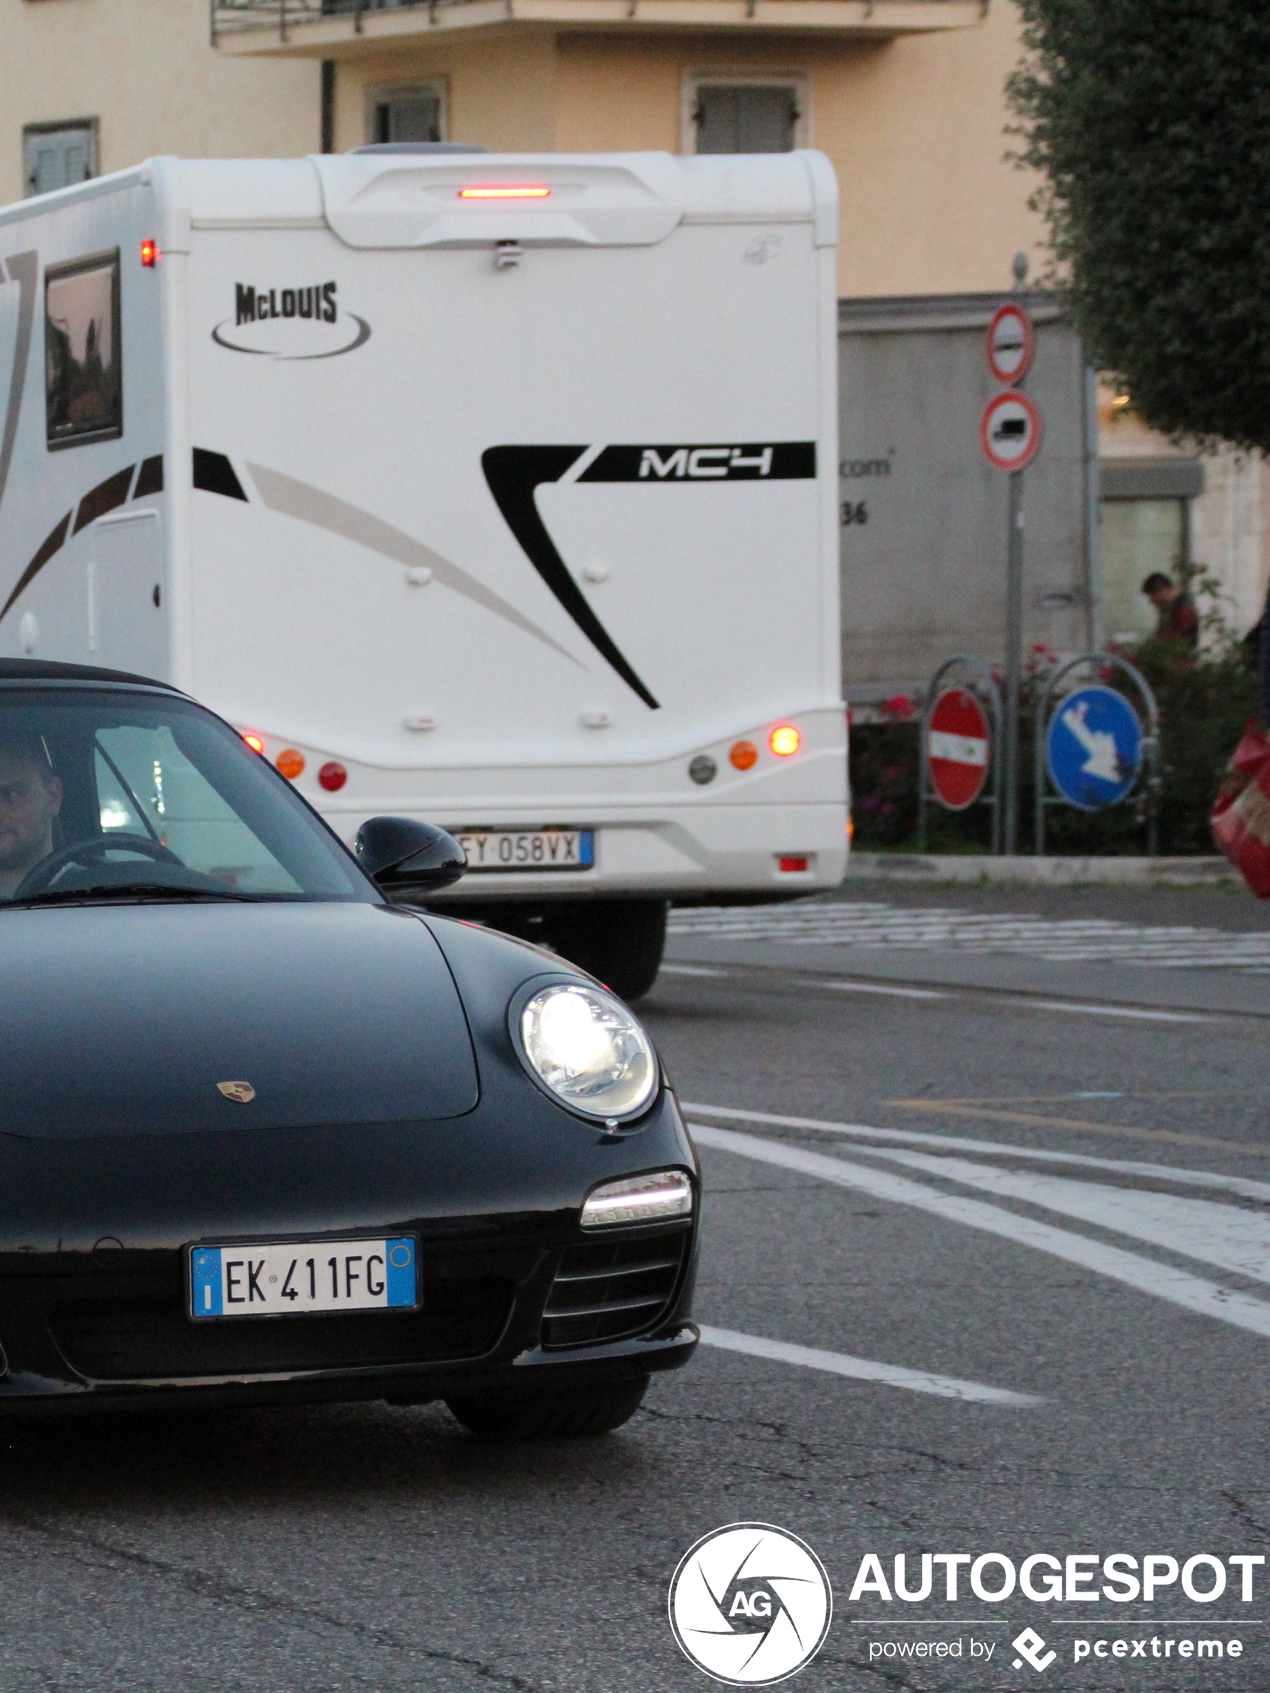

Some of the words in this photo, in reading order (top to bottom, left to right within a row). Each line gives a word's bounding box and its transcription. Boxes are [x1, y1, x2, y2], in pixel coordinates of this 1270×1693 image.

[498, 834, 577, 862] 058VX
[226, 1259, 267, 1303] EK
[280, 1254, 385, 1301] 411FG
